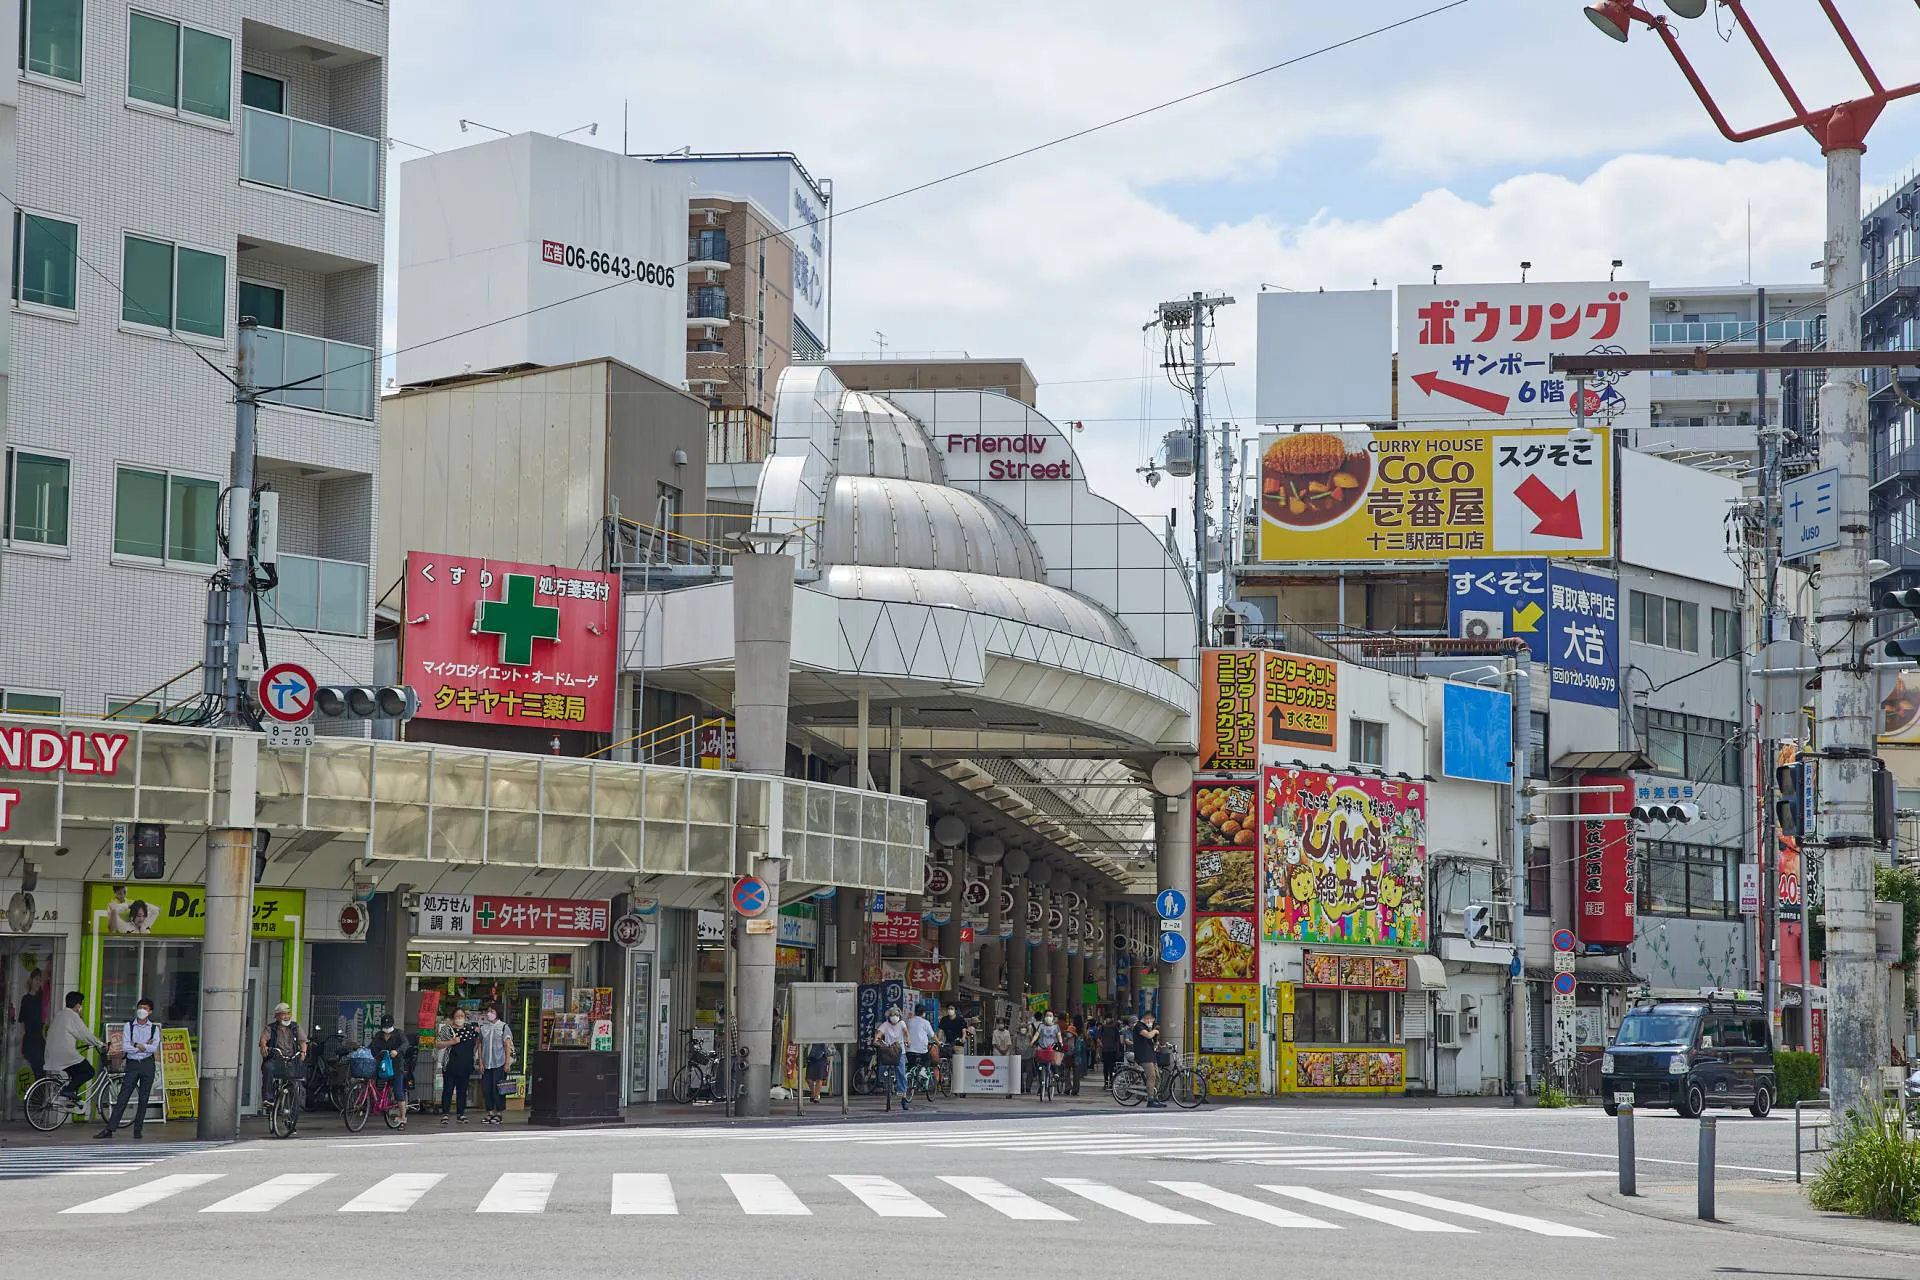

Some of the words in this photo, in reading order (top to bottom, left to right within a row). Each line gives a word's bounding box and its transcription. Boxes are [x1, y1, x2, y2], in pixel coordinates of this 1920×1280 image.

[543, 242, 562, 262] 広告
[566, 246, 675, 288] 06-6643-0606
[1418, 291, 1629, 345] ボウリング
[1452, 351, 1565, 376] サンポー
[1518, 380, 1565, 405] 6階
[947, 433, 1047, 454] Friendly
[1367, 440, 1420, 453] CURRY
[1426, 438, 1484, 452] HOUSE
[1499, 443, 1594, 468] スグそこ
[988, 459, 1071, 479] Street
[1377, 454, 1475, 485] CoCo
[1366, 487, 1485, 528] 壱番屋
[1366, 531, 1485, 551] 十三駅西口店
[1800, 523, 1821, 543] Juso
[421, 563, 493, 588] くすり
[1452, 571, 1545, 595] すぐそこ
[538, 575, 610, 602] 処方箋受付
[1551, 584, 1616, 621] 買取専門店
[1563, 620, 1605, 666] 大吉
[422, 661, 599, 688] マイクロダイエット・オードムーゲ
[1266, 656, 1336, 687] インターネット
[1564, 671, 1616, 692] 0120-500-979
[434, 684, 587, 721] タキヤ十三薬局
[1217, 654, 1236, 757] コミックカフェ
[1237, 652, 1256, 757] インターネット
[1265, 682, 1337, 711] コミックカフェ
[268, 738, 313, 746] ここから
[1639, 787, 1694, 799] 時差信号
[113, 824, 125, 877] 斜め横断専用
[424, 897, 471, 912] 処方せん
[430, 915, 463, 931] 調剤
[499, 903, 607, 933] タキヤ十三薬局
[421, 954, 549, 973] 処方せん受付いたします
[912, 967, 943, 982] 王将
